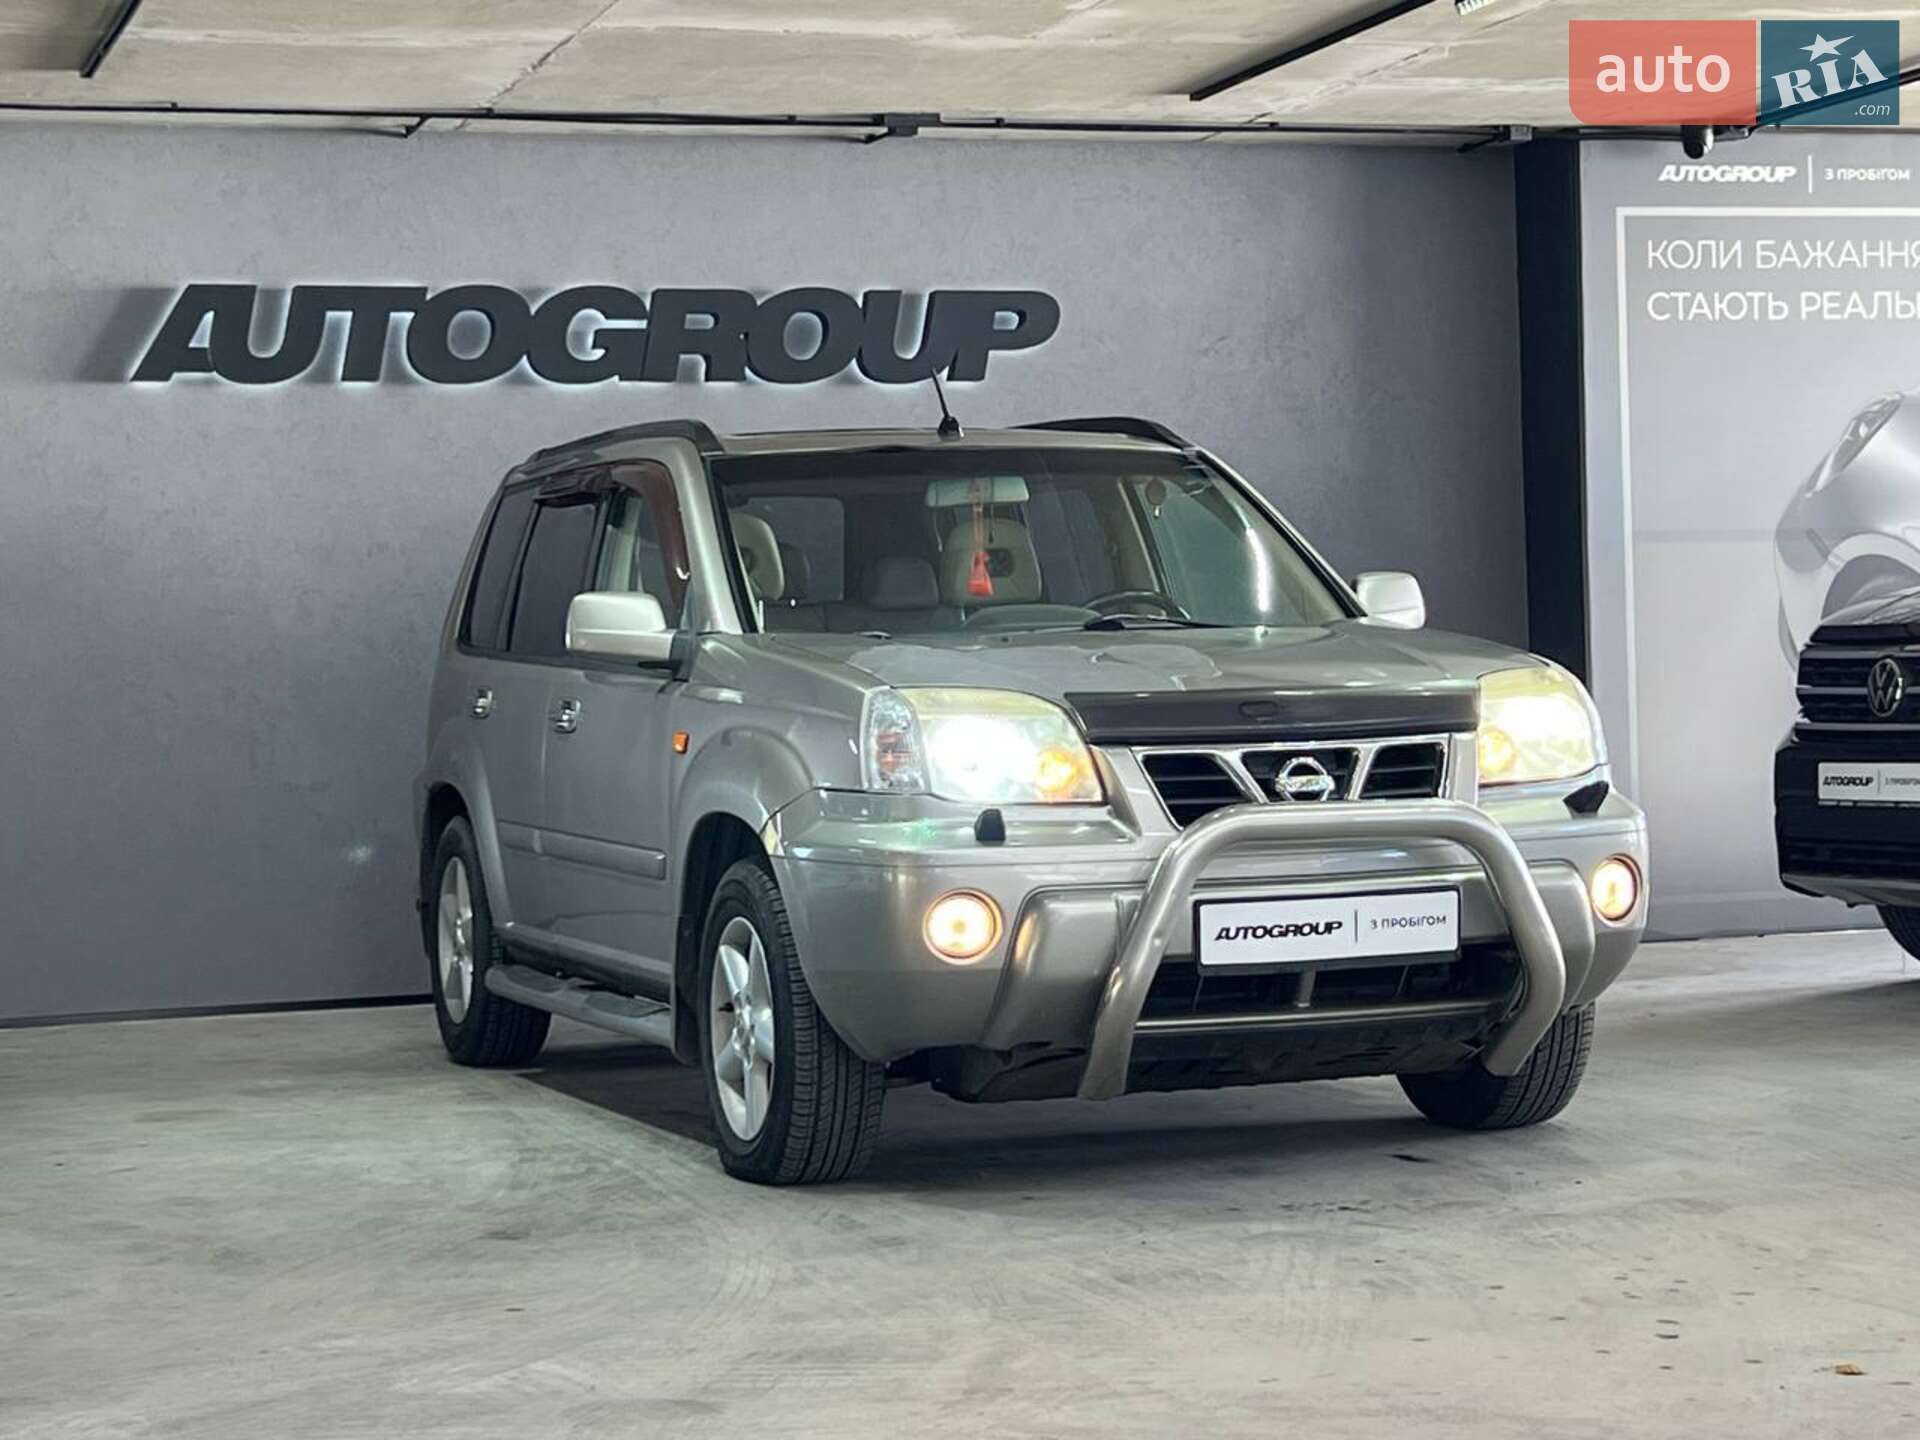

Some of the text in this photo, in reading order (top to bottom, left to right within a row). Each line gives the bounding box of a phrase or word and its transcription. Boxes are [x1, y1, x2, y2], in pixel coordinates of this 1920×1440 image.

[1658, 165, 1797, 182] AUTOGROUP
[1837, 168, 1910, 181] ПРОБІГОМ
[1647, 239, 1742, 269] КОЛИ
[1646, 291, 1920, 320] СТАЮТЬ РЕАЛЬ
[129, 284, 1060, 384] AUTOGROUP
[1214, 921, 1343, 941] AUTOGROUP
[1381, 915, 1446, 929] ПРОБІГОМ
